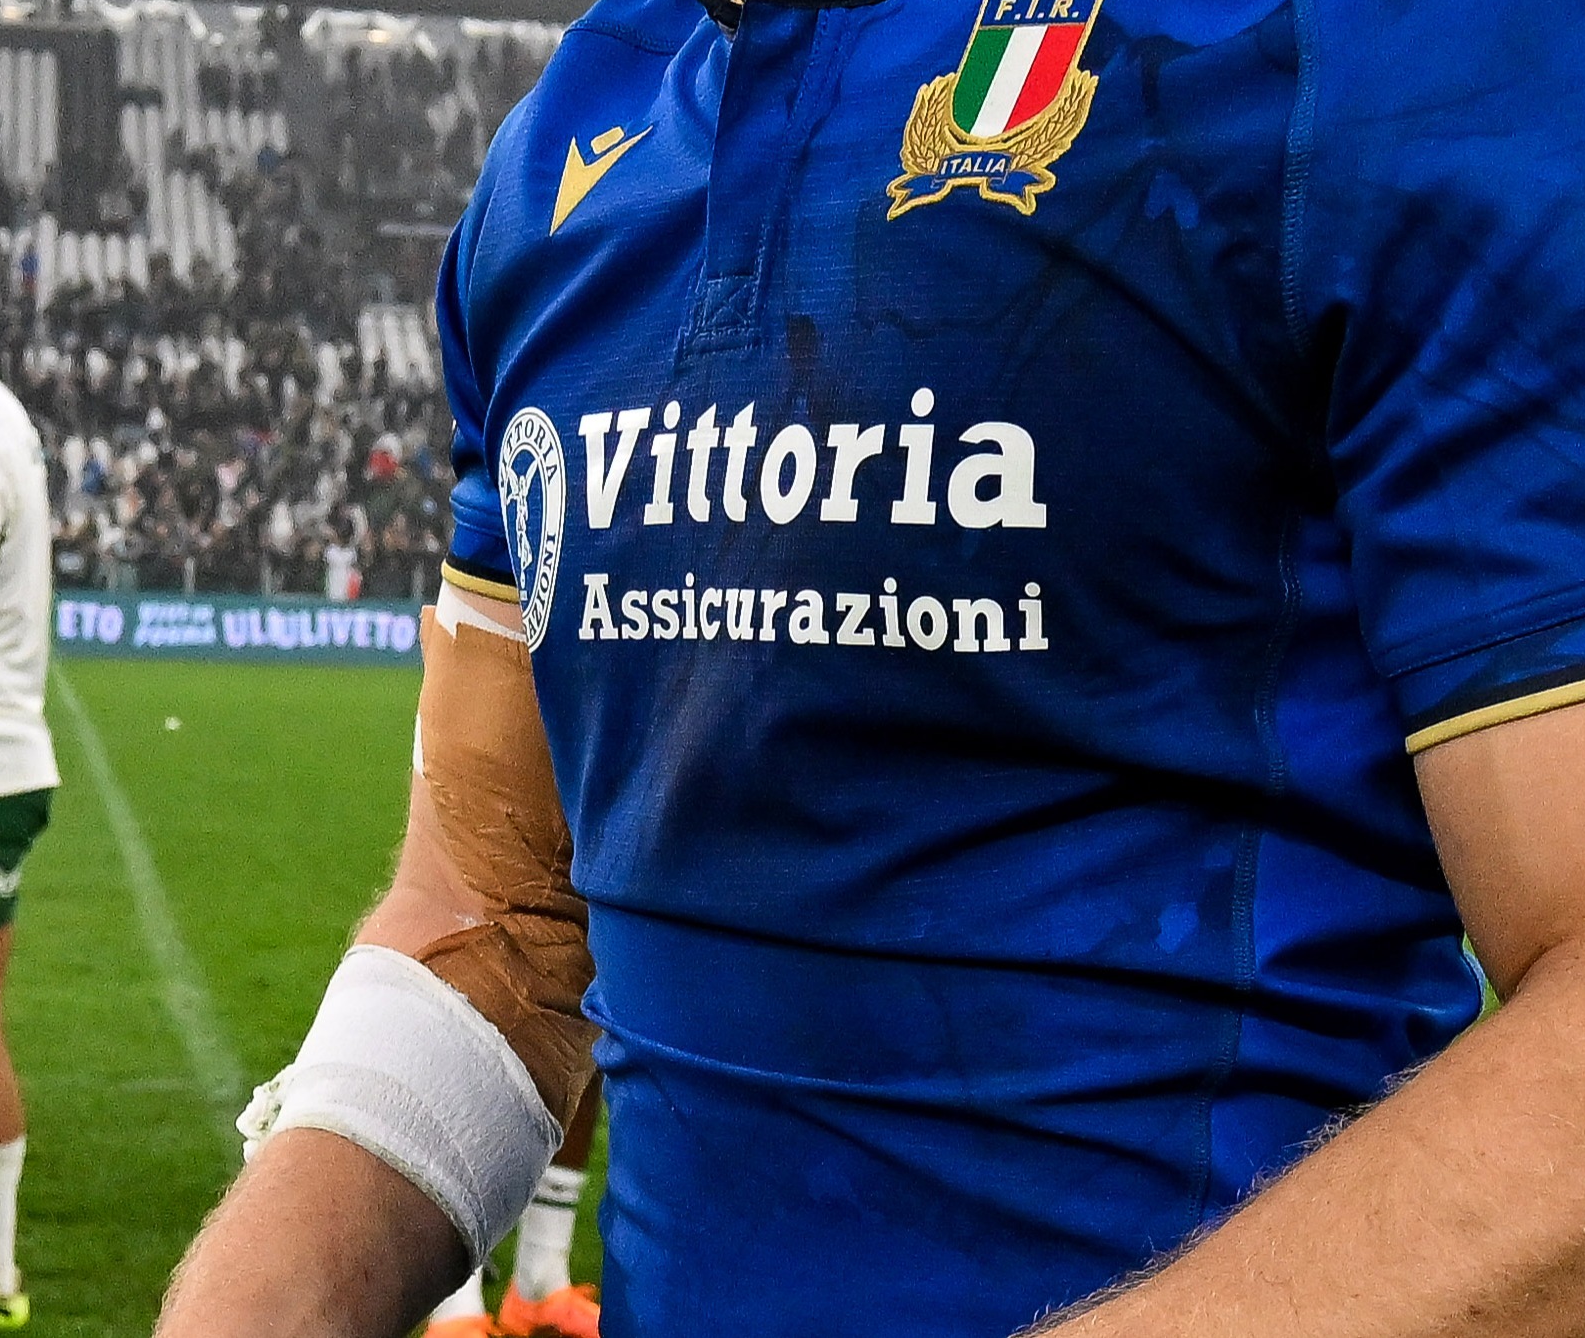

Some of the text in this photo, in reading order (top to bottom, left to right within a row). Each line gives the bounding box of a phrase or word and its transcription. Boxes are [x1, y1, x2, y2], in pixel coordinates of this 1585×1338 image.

[941, 158, 1006, 175] ITALIA
[578, 387, 1047, 529] Vittoria
[58, 601, 124, 643] ETO
[578, 572, 1049, 652] Assicurazioni
